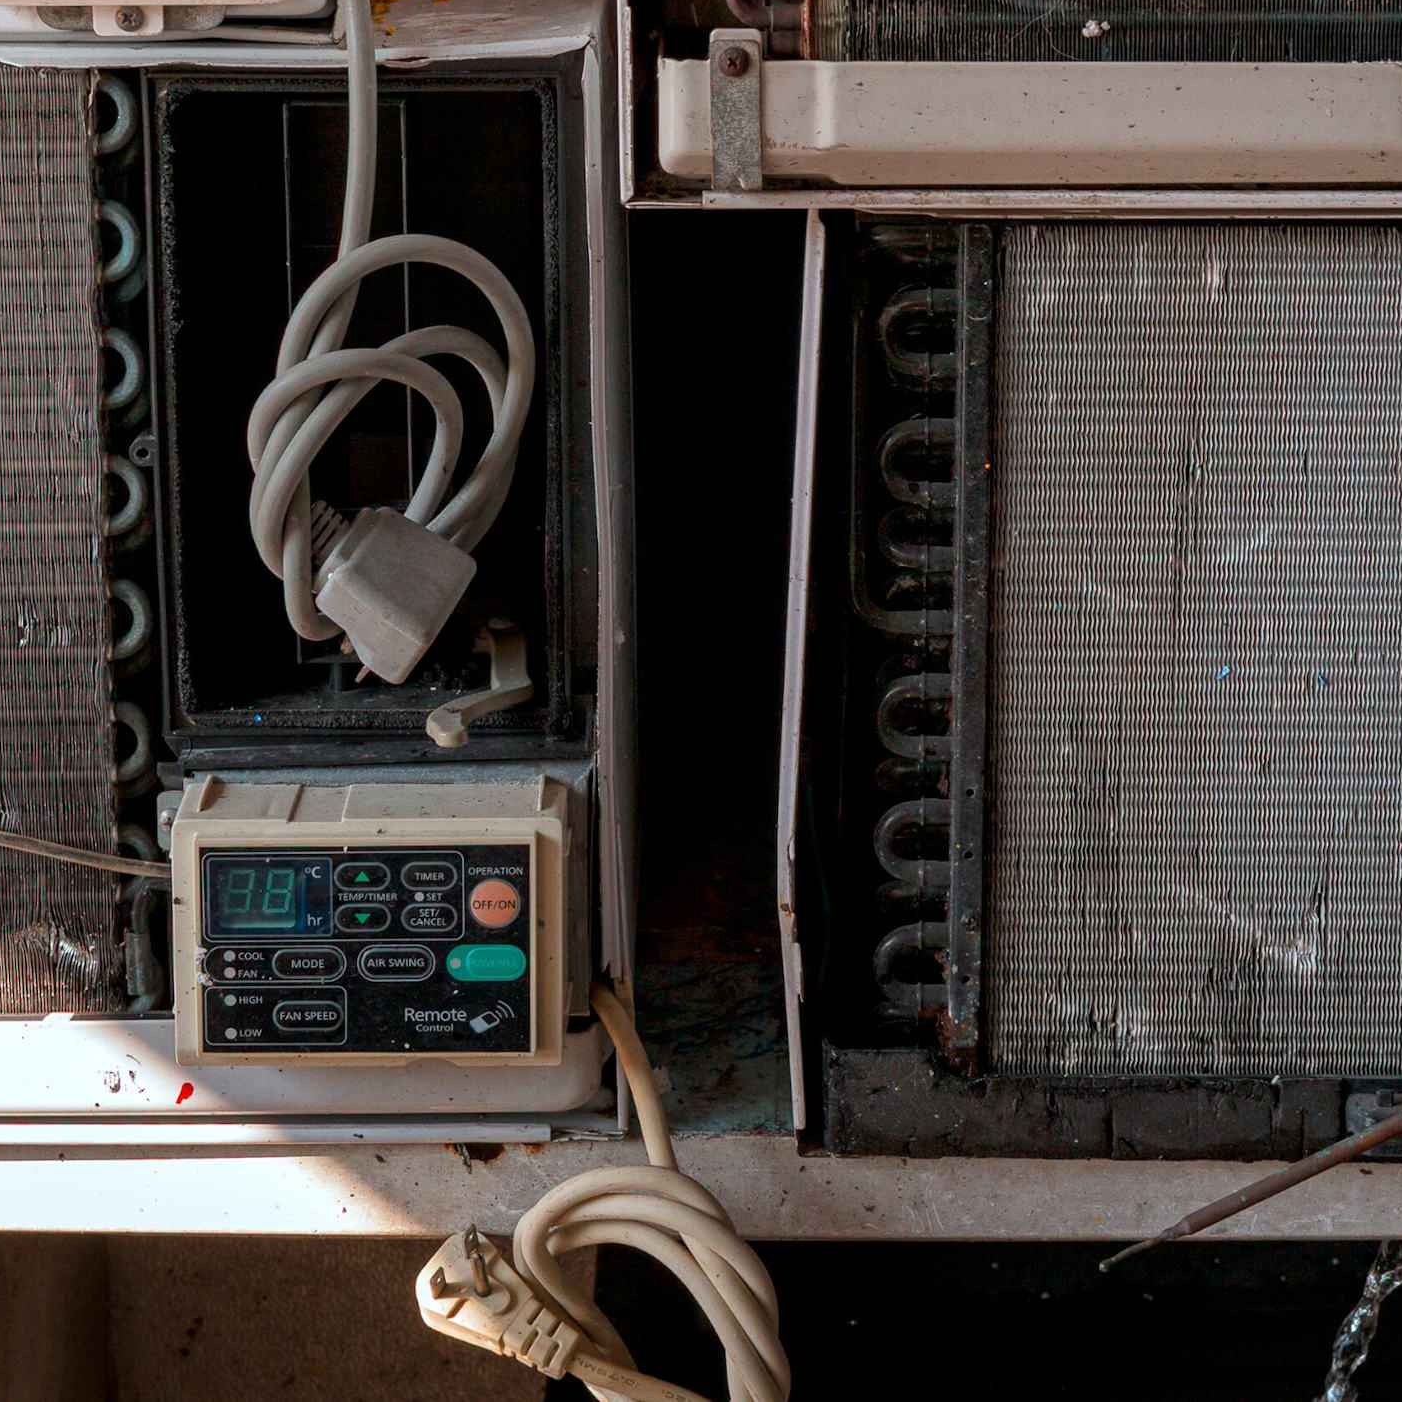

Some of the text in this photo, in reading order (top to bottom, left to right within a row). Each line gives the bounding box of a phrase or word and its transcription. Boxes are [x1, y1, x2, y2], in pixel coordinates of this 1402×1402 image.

[468, 866, 524, 876] OPERATION
[414, 872, 445, 881] TIMER
[338, 892, 398, 902] TEMP/TIMER
[425, 892, 443, 901] SET
[472, 899, 516, 910] OFF/ON
[419, 908, 440, 918] SET/
[307, 914, 322, 927] hr
[410, 917, 447, 927] CANCEL
[238, 952, 265, 961] COOL
[291, 959, 325, 969] MODE
[367, 958, 425, 968] AIR SWING
[238, 969, 258, 978] FAN
[238, 996, 263, 1005] HIGH
[279, 1012, 338, 1021] FAN SPEED
[404, 1008, 467, 1022] Remote
[415, 1023, 454, 1032] Control
[239, 1029, 262, 1037] LOW
